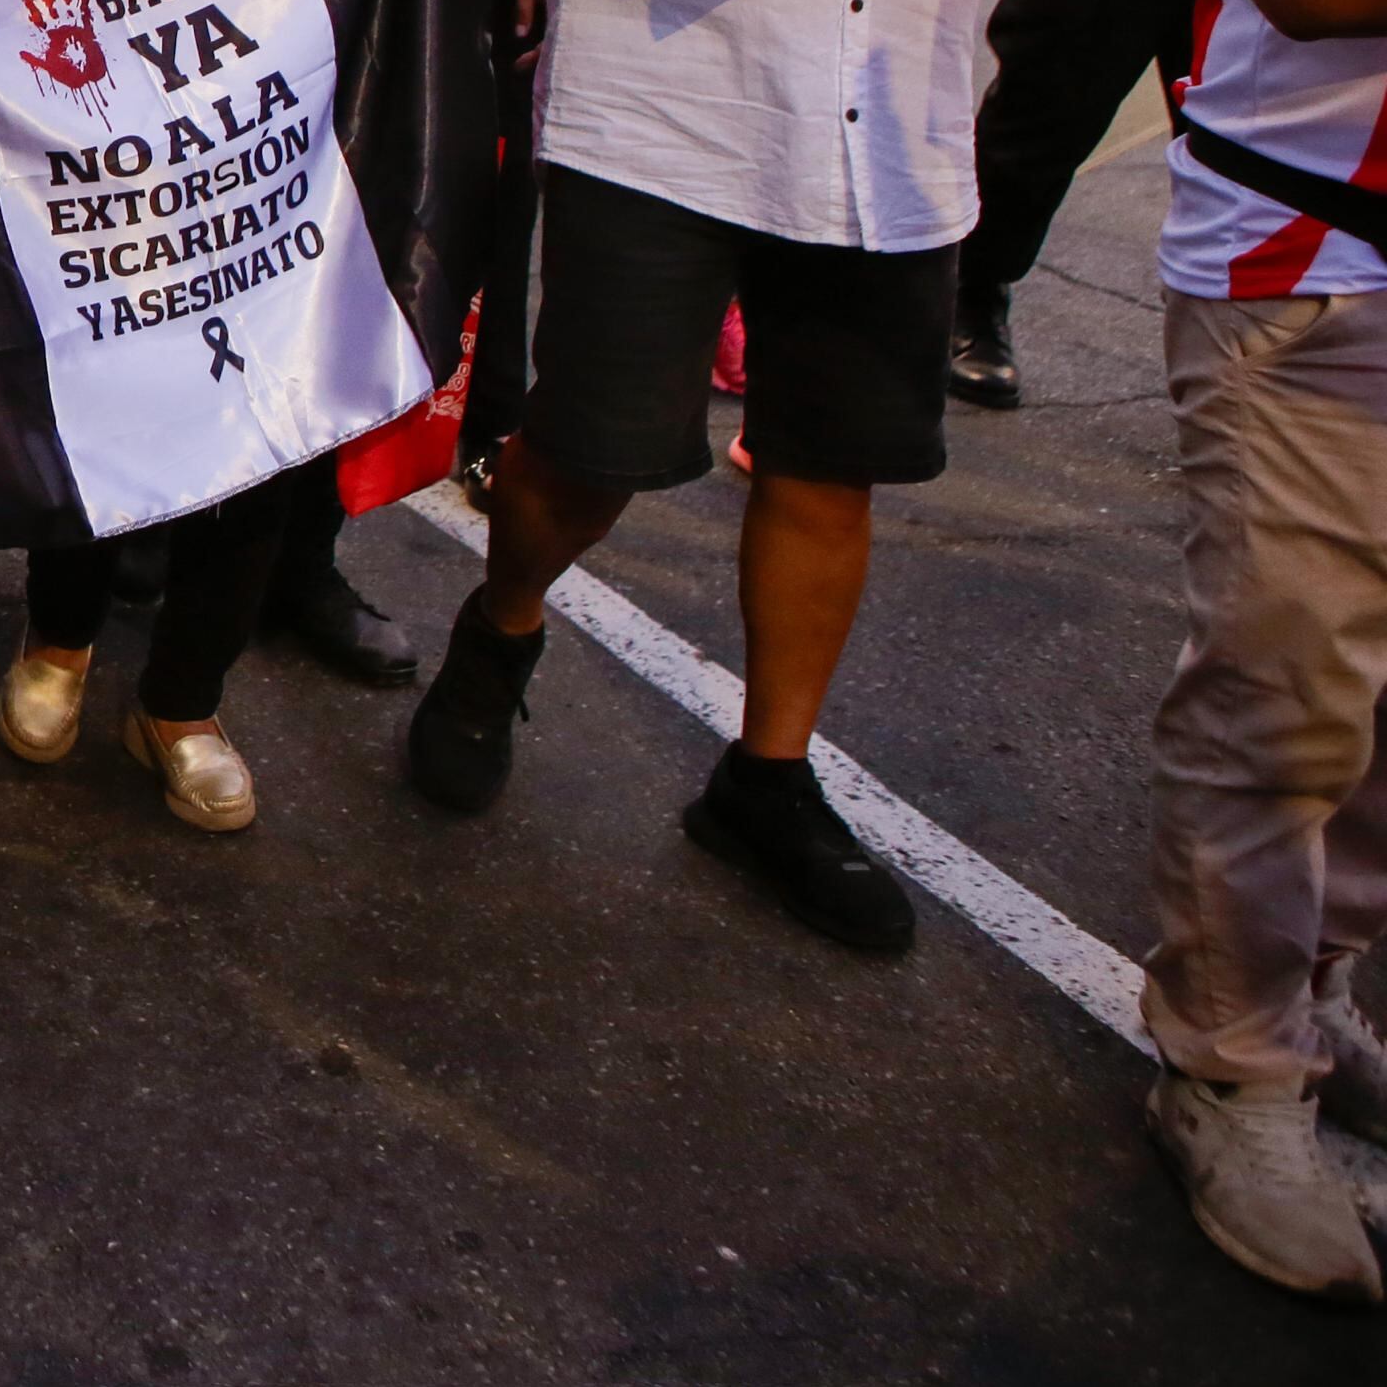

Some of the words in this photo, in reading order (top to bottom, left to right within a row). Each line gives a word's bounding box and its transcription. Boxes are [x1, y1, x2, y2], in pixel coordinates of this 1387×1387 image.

[128, 4, 260, 94] YA
[45, 135, 153, 187] NO
[167, 114, 215, 167] A
[213, 70, 300, 143] LA
[46, 116, 311, 236] EXTORSIÓN
[59, 170, 310, 289] SICARIATO
[78, 306, 104, 342] Y
[113, 220, 325, 339] ASESINATO
